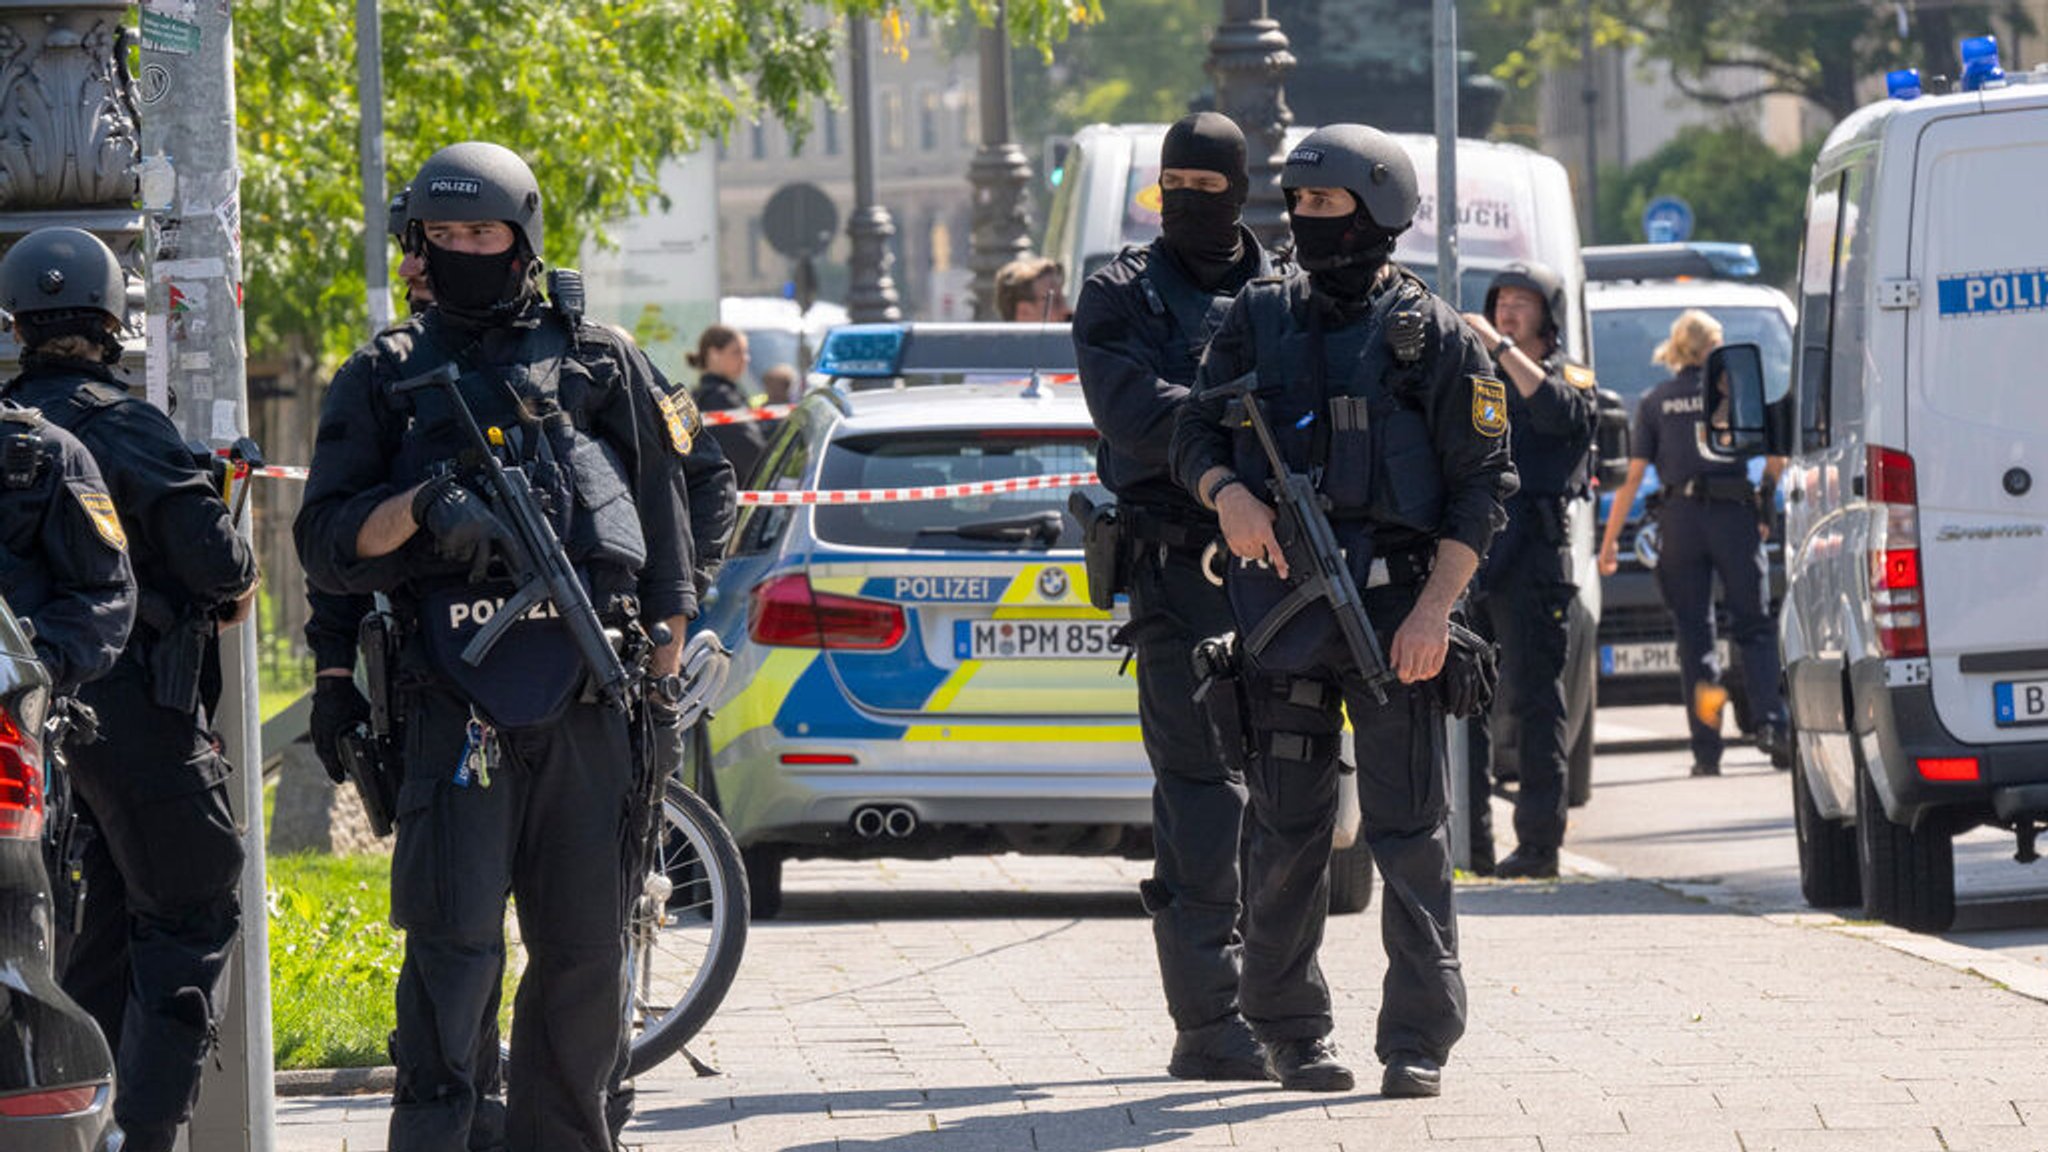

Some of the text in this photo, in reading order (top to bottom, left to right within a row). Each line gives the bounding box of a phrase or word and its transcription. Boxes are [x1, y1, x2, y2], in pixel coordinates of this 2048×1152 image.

[431, 180, 478, 194] POLIZEI
[1966, 275, 2048, 310] POLI
[895, 578, 990, 600] POLIZEI
[975, 624, 1135, 654] M PM 858
[2026, 686, 2045, 715] B
